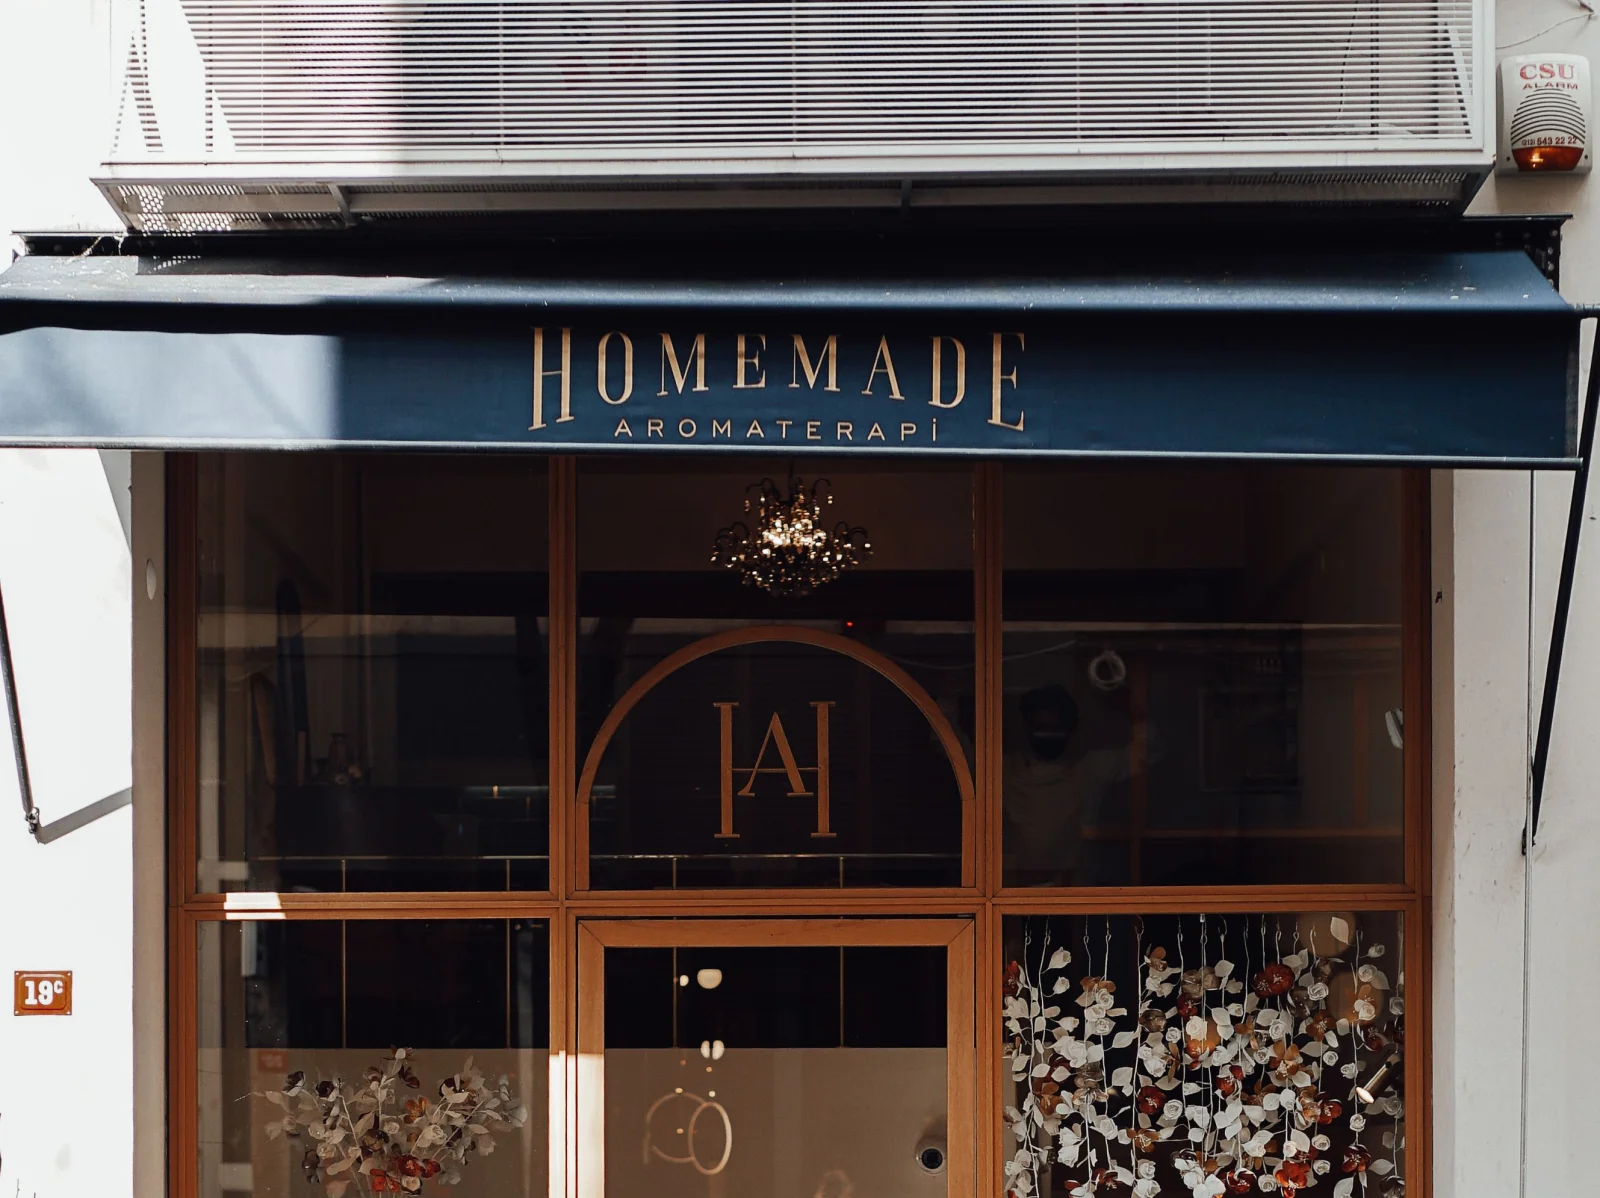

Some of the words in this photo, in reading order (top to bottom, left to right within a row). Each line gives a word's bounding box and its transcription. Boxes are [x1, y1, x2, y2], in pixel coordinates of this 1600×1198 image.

[1519, 63, 1575, 80] CSU
[1522, 82, 1578, 90] ALARM
[1537, 136, 1553, 145] 543
[1555, 136, 1566, 145] 22
[528, 326, 1024, 432] HOMEMADE
[614, 418, 937, 442] AROMATERAPİ
